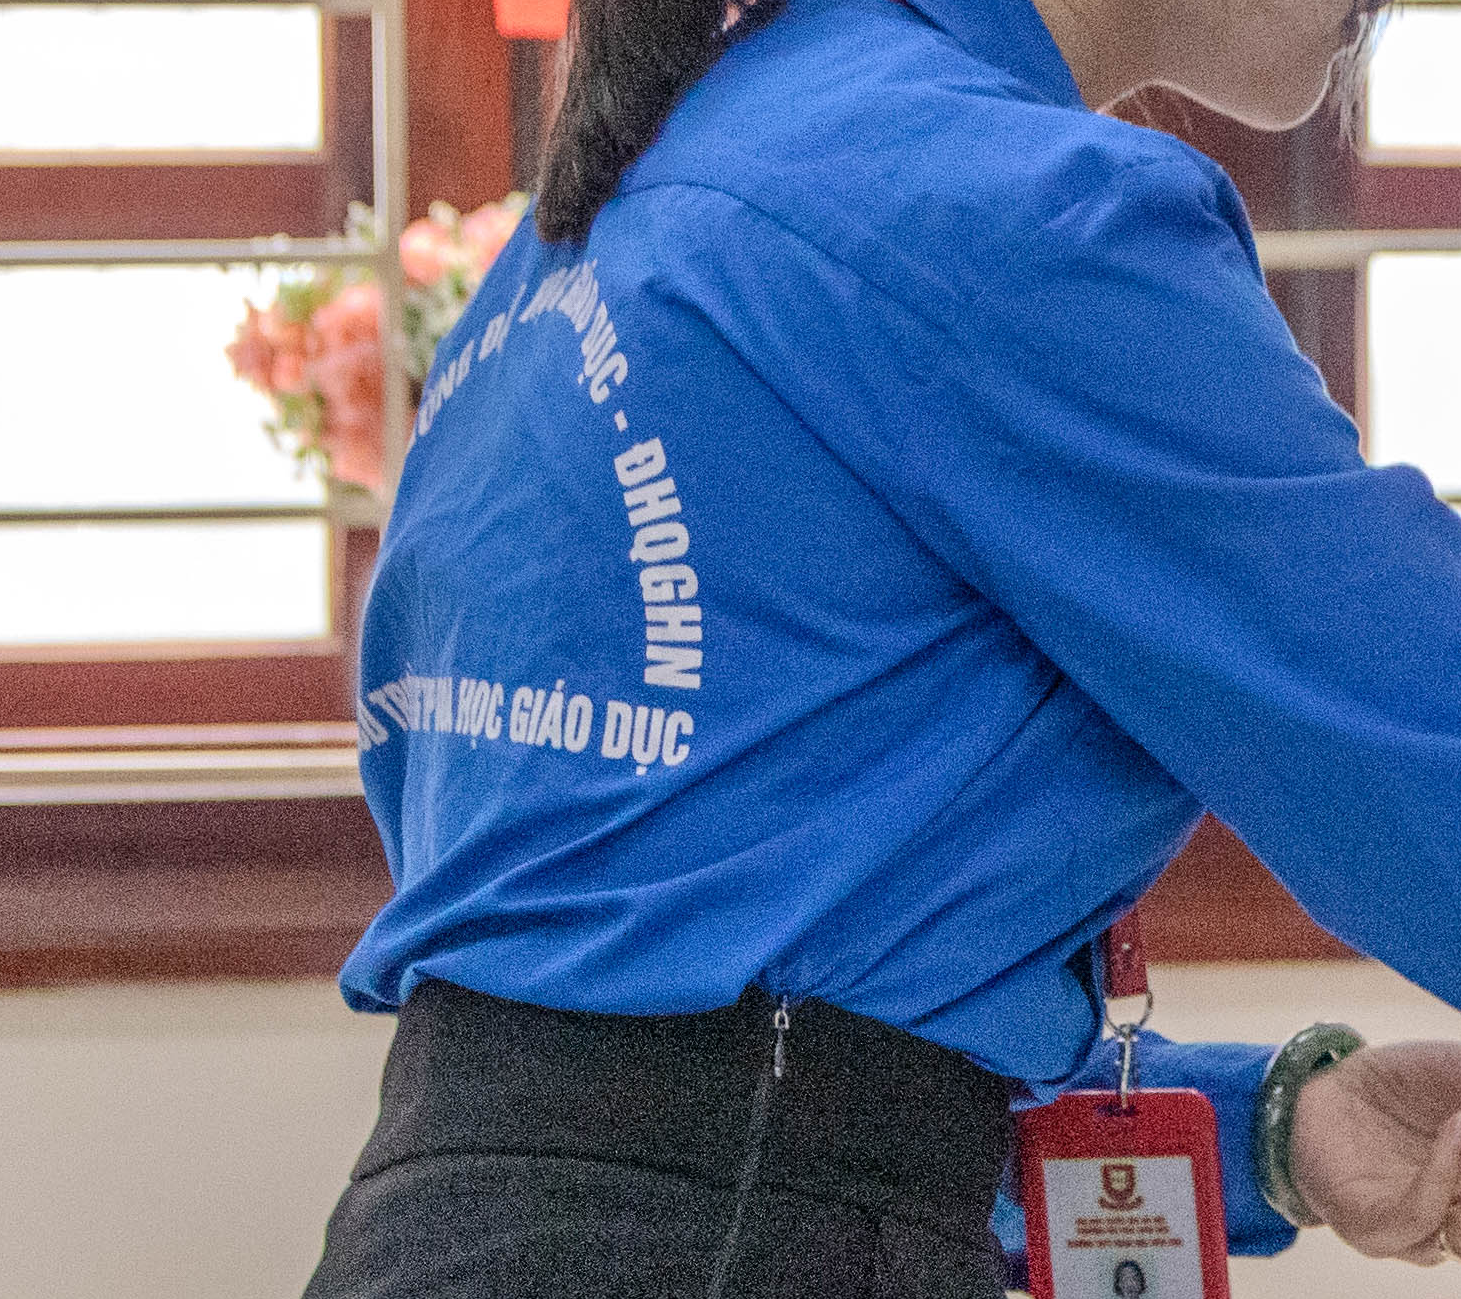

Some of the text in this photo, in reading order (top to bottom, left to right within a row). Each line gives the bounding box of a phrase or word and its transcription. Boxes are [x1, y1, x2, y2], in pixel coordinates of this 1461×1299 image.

[613, 436, 703, 690] ĐHQGHN
[456, 677, 507, 750] HỌC
[509, 678, 592, 754] GIÁO
[601, 702, 694, 775] DỤC
